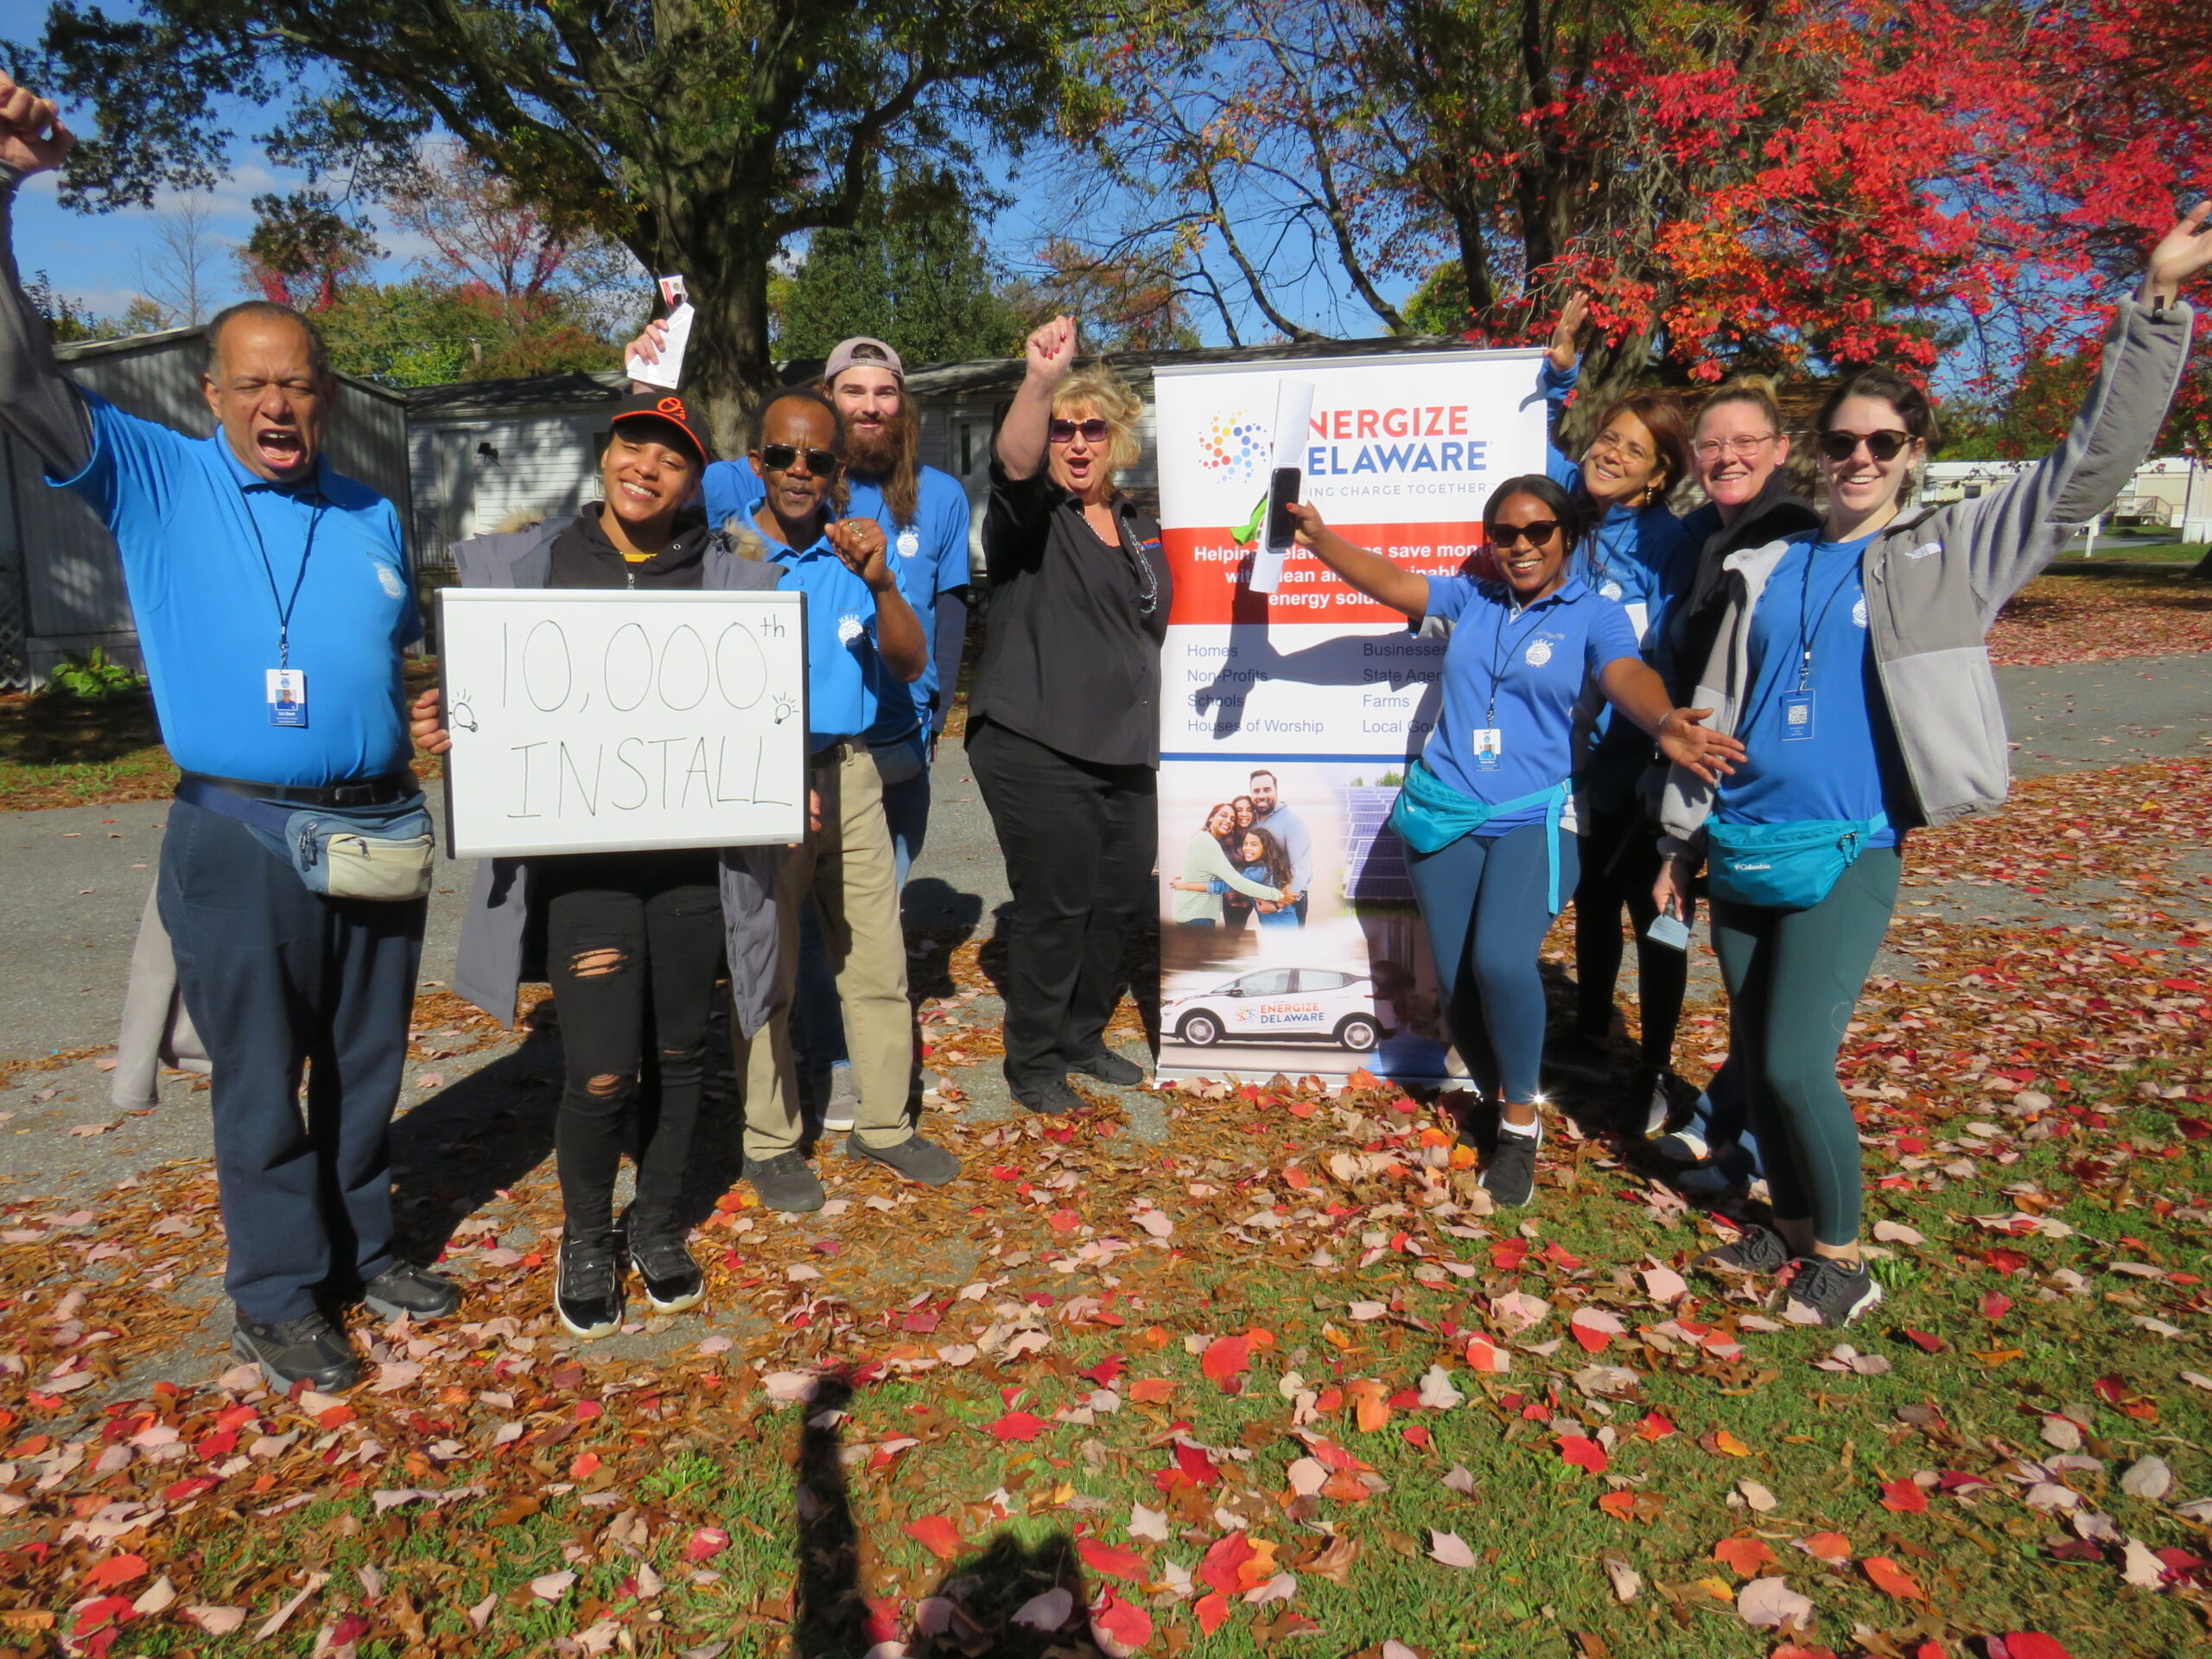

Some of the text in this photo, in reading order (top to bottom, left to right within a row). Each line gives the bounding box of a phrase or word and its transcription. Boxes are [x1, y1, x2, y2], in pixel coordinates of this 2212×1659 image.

[1307, 405, 1469, 441] NERGIZE
[1307, 441, 1487, 475] ELAWARE
[1309, 482, 1492, 498] ING CHARGE TOGETHER.
[1388, 546, 1432, 558] save
[1224, 569, 1343, 584] wit lean an
[1268, 593, 1330, 609] energy
[1187, 644, 1238, 657] Homes
[1363, 643, 1449, 657] Businesses
[1187, 669, 1268, 682] Non-Profits
[1363, 669, 1402, 682] State
[1187, 694, 1245, 707] Schools
[1363, 695, 1410, 708] Farms
[1187, 719, 1325, 735] Houses of Worship
[1363, 720, 1402, 733] Local
[507, 735, 793, 818] INSTALL
[1260, 1002, 1319, 1014] ENERGIZE
[1260, 1012, 1325, 1024] DELAWARE
